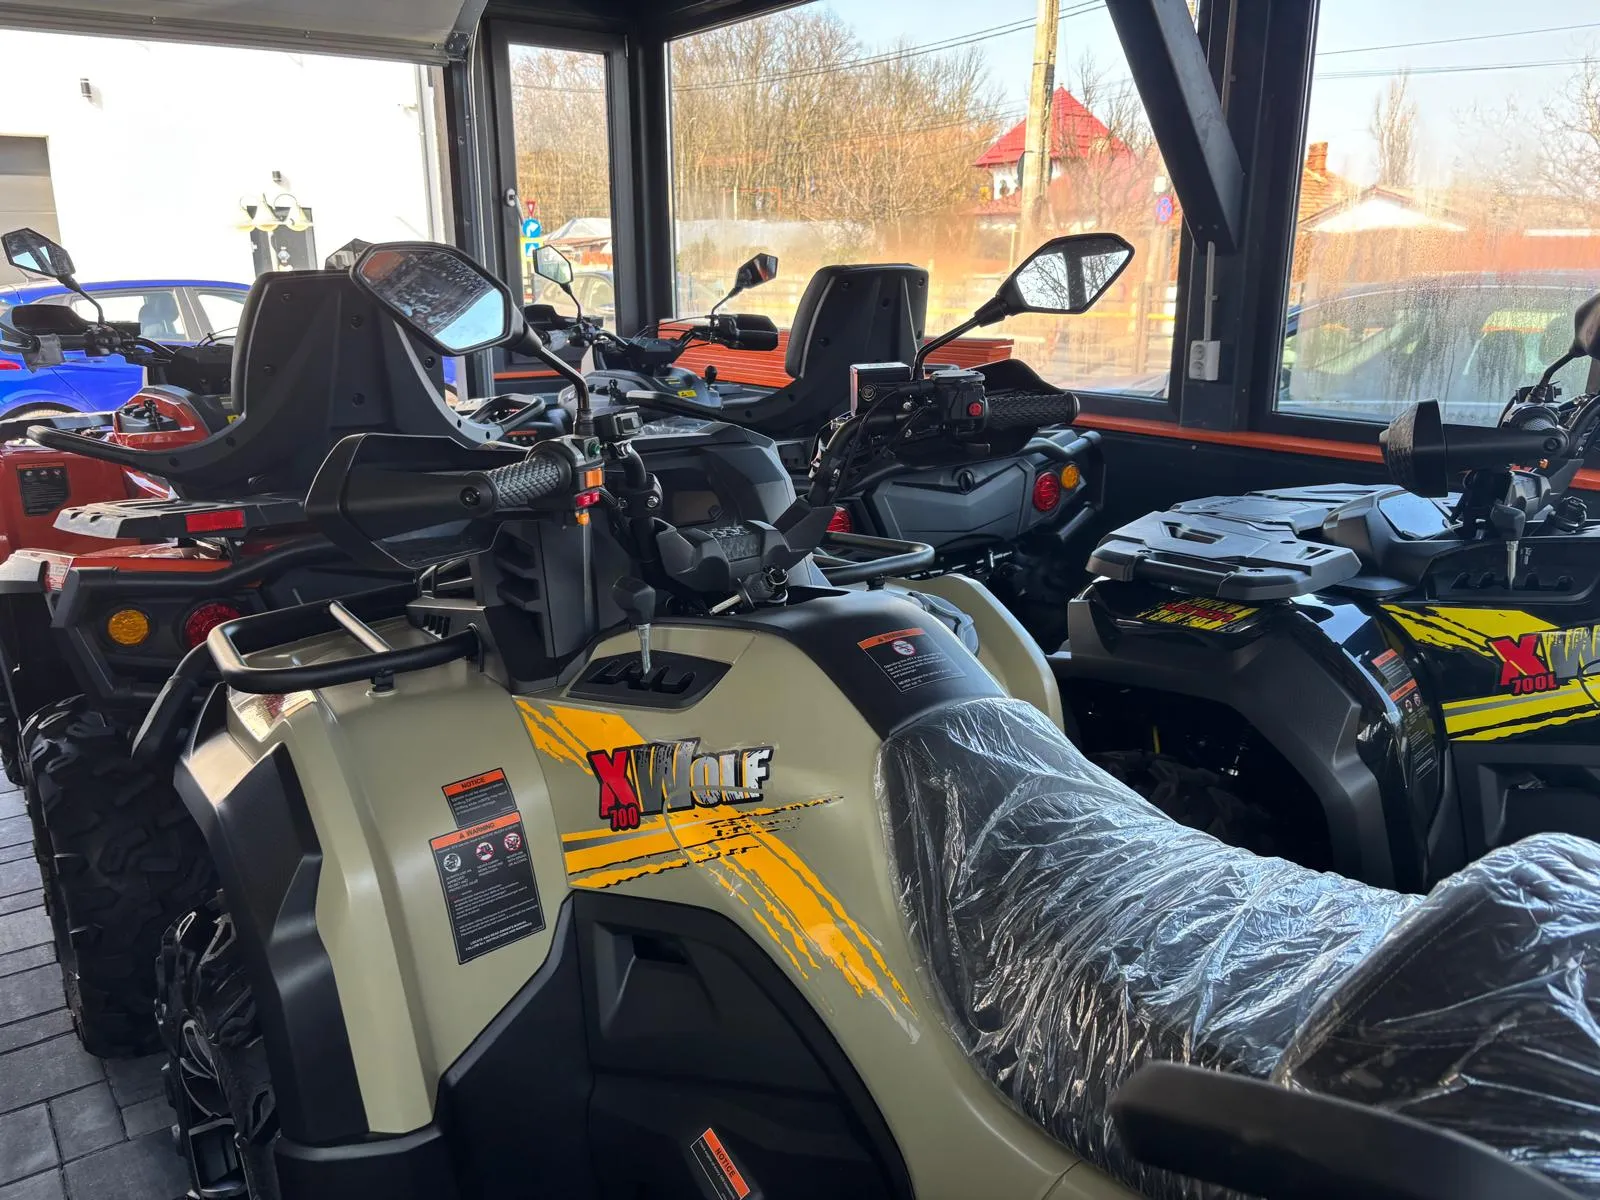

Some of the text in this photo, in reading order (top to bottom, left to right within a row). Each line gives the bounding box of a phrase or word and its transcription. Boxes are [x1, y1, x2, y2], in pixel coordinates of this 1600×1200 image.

[1511, 673, 1558, 695] 700L
[461, 776, 486, 789] NOTICE
[611, 806, 639, 829] 700
[466, 822, 496, 836] WARNING
[714, 1147, 736, 1178] NOTICE
